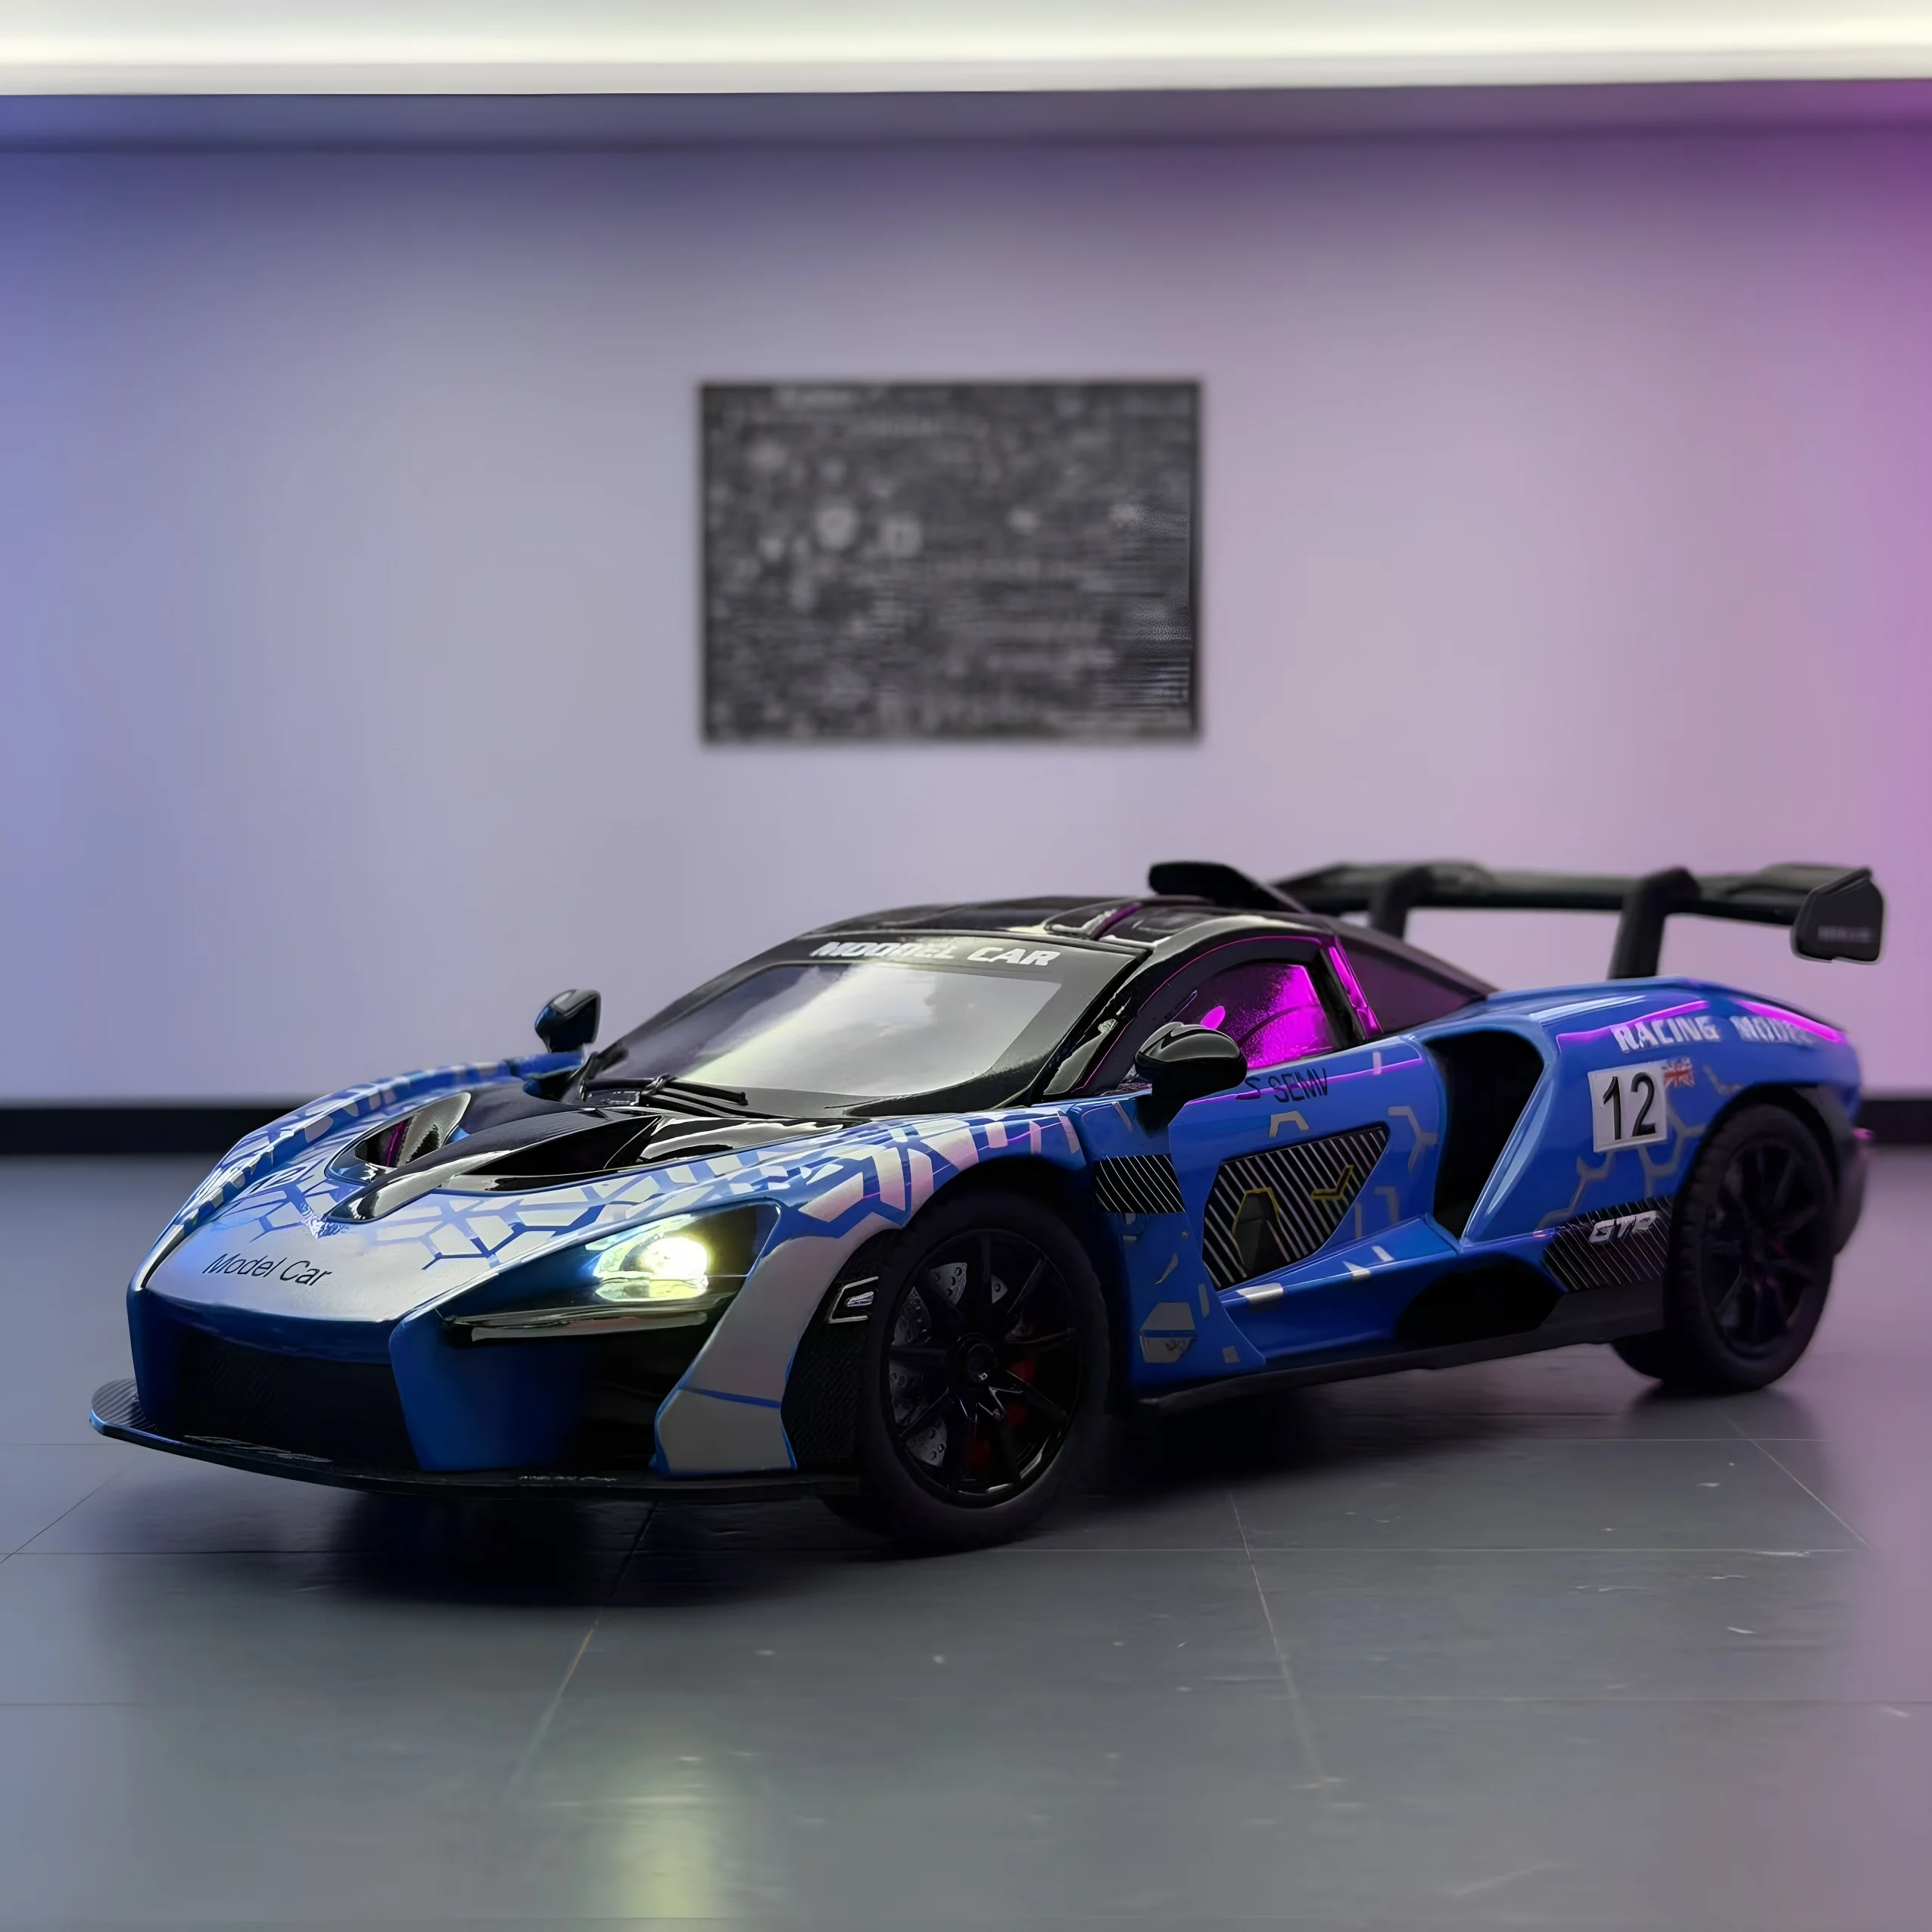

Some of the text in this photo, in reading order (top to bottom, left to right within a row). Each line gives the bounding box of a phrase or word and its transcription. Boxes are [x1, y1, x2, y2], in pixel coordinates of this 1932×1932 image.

[967, 946, 1061, 966] CAR
[1609, 1015, 1722, 1053] RACING
[1603, 1071, 1656, 1141] 12
[201, 1253, 332, 1286] Model Car
